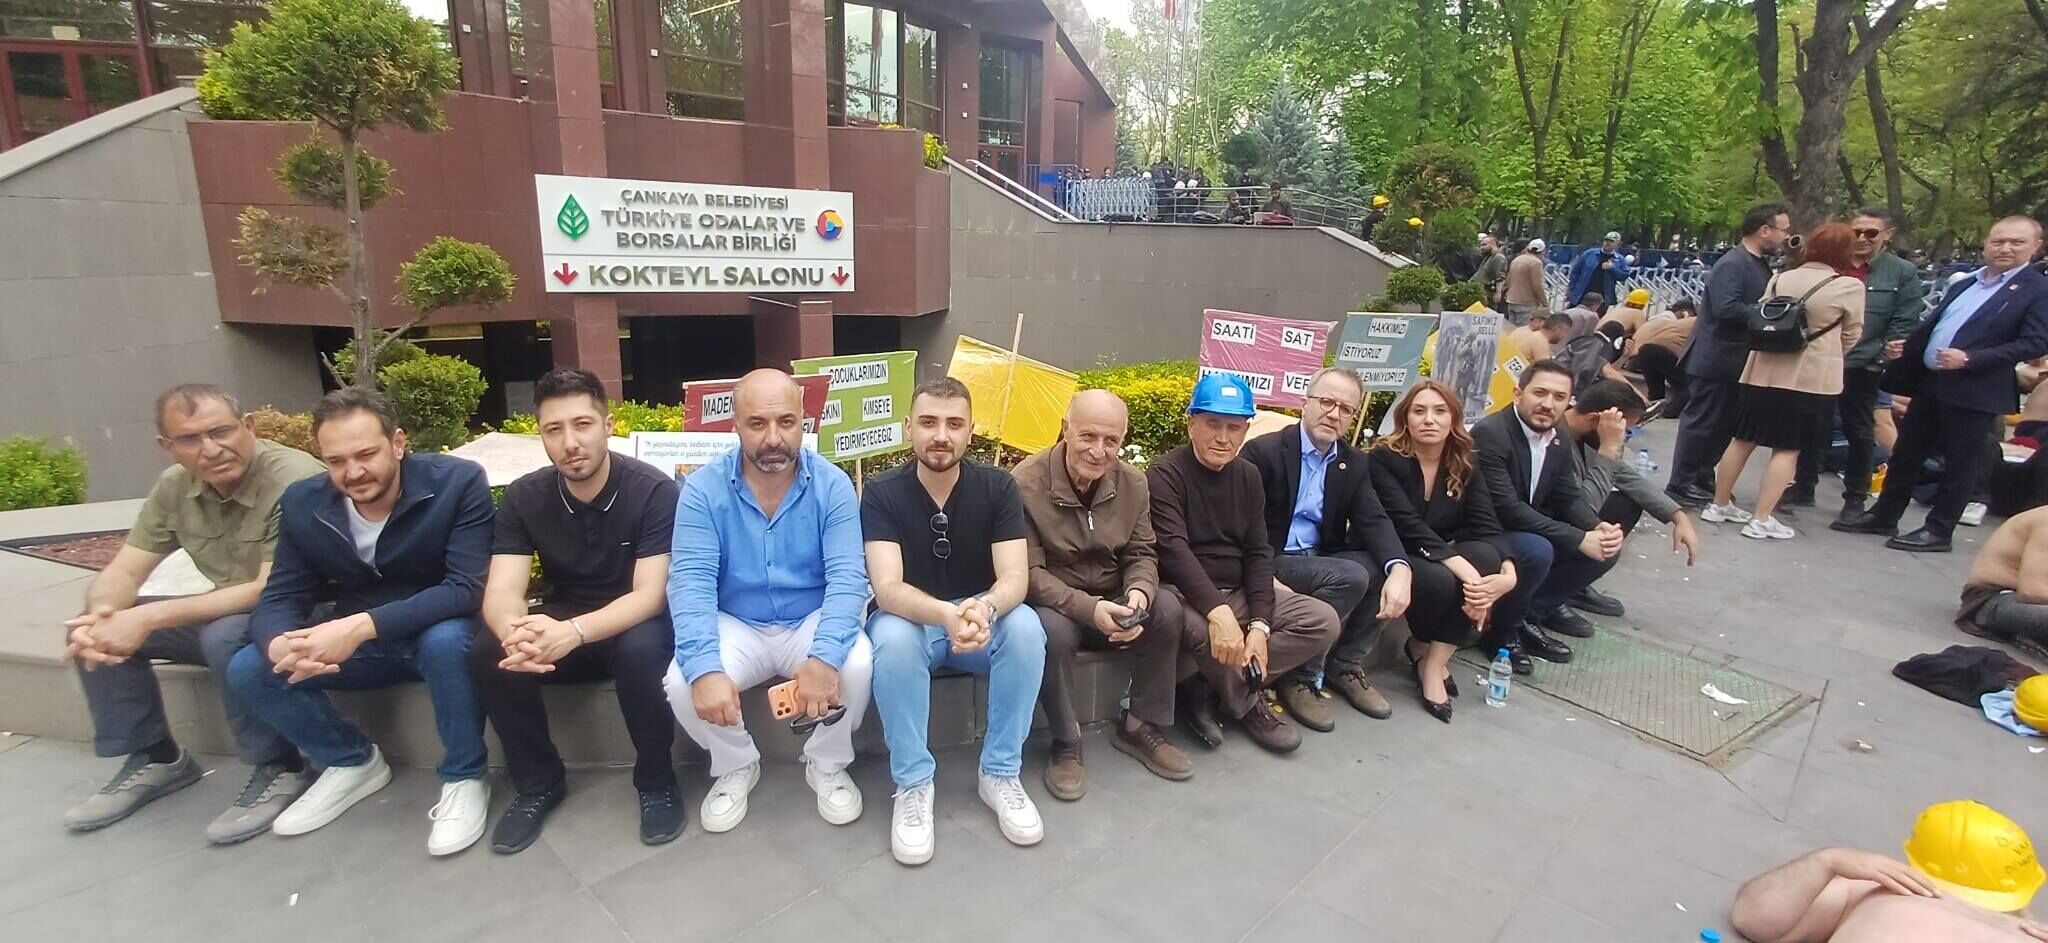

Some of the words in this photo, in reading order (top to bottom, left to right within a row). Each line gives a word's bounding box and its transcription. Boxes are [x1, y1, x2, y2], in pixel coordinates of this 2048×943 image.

[621, 189, 698, 206] ÇANKAYA
[705, 193, 788, 210] BELEDİYESİ
[601, 207, 692, 229] TÜRKİYE
[699, 213, 778, 231] ODALAR
[782, 216, 806, 232] VE
[616, 232, 728, 250] BORSALAR
[732, 232, 796, 252] BİRLİĞİ
[589, 265, 718, 286] KOKTEYL
[724, 266, 824, 286] SALONU
[1213, 322, 1256, 339] SAATİ
[1284, 330, 1312, 346] SAT
[1343, 343, 1382, 359] İSTİYORUZ
[864, 398, 890, 416] KİMSEYE
